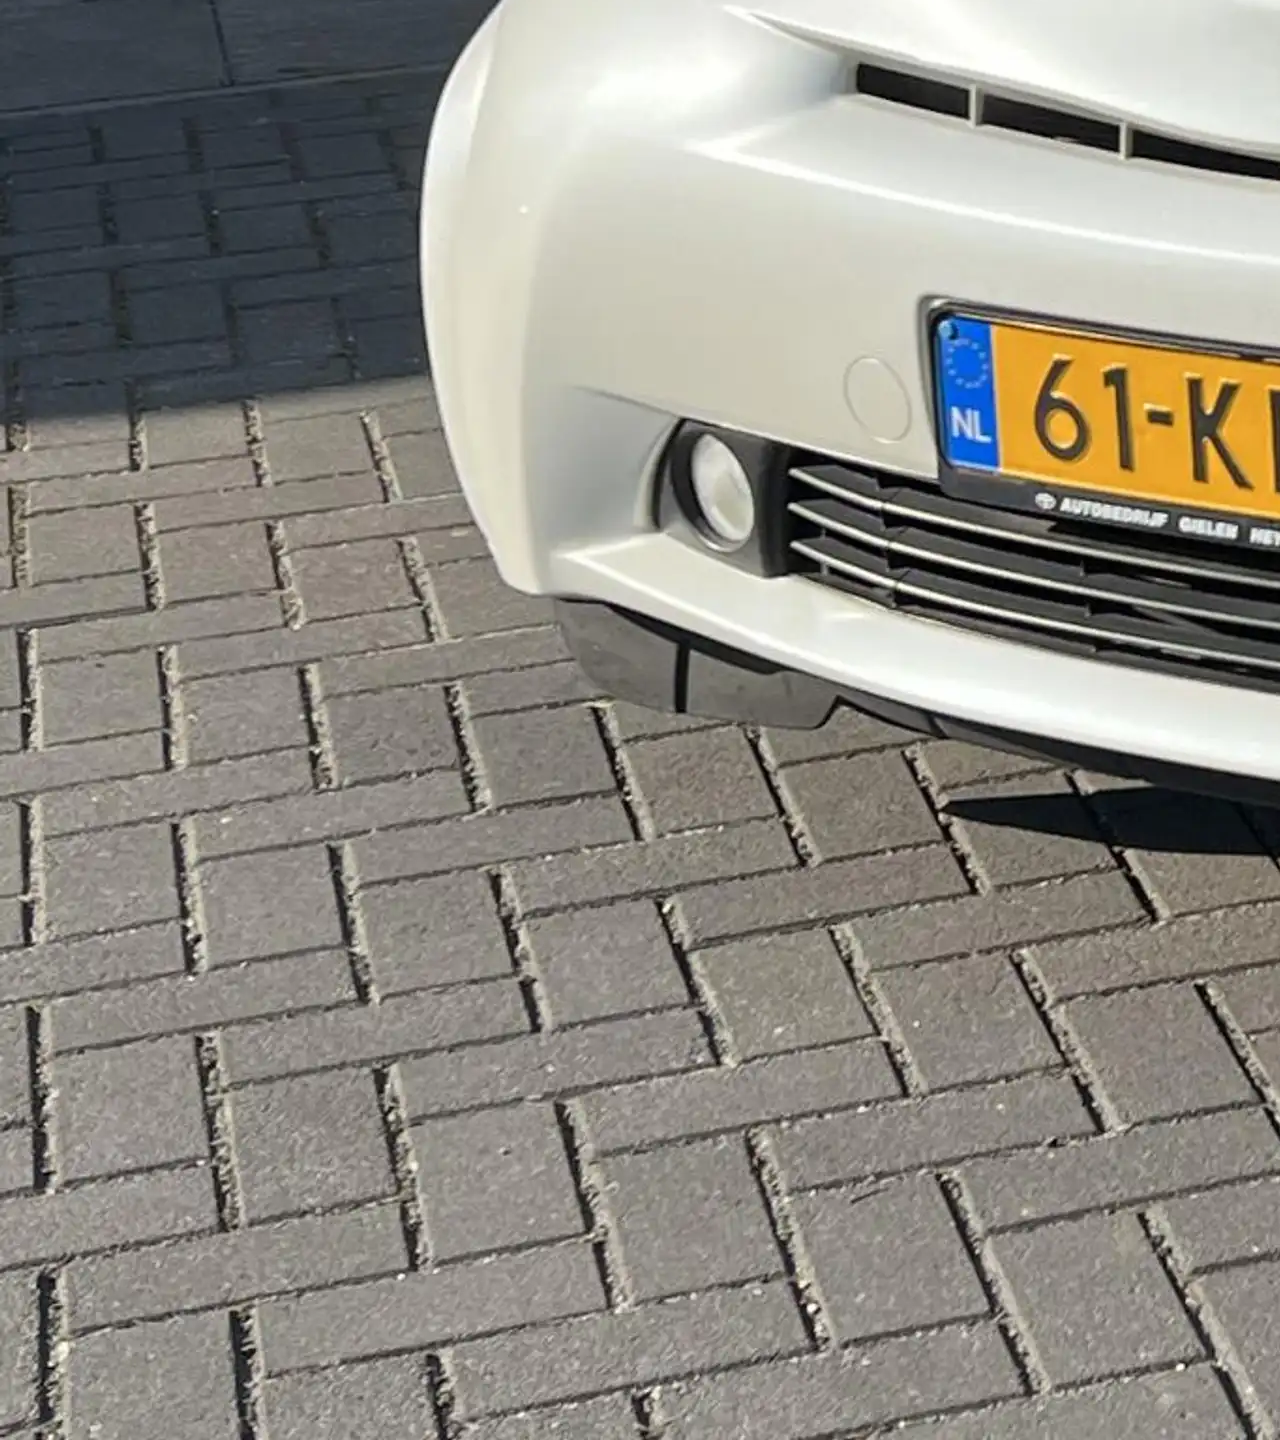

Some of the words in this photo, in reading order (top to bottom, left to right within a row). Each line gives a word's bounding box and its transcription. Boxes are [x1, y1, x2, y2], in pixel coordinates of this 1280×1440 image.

[950, 405, 992, 444] NL
[1059, 496, 1169, 529] AUTOBEDRIJF
[1178, 515, 1240, 541] GIELEN
